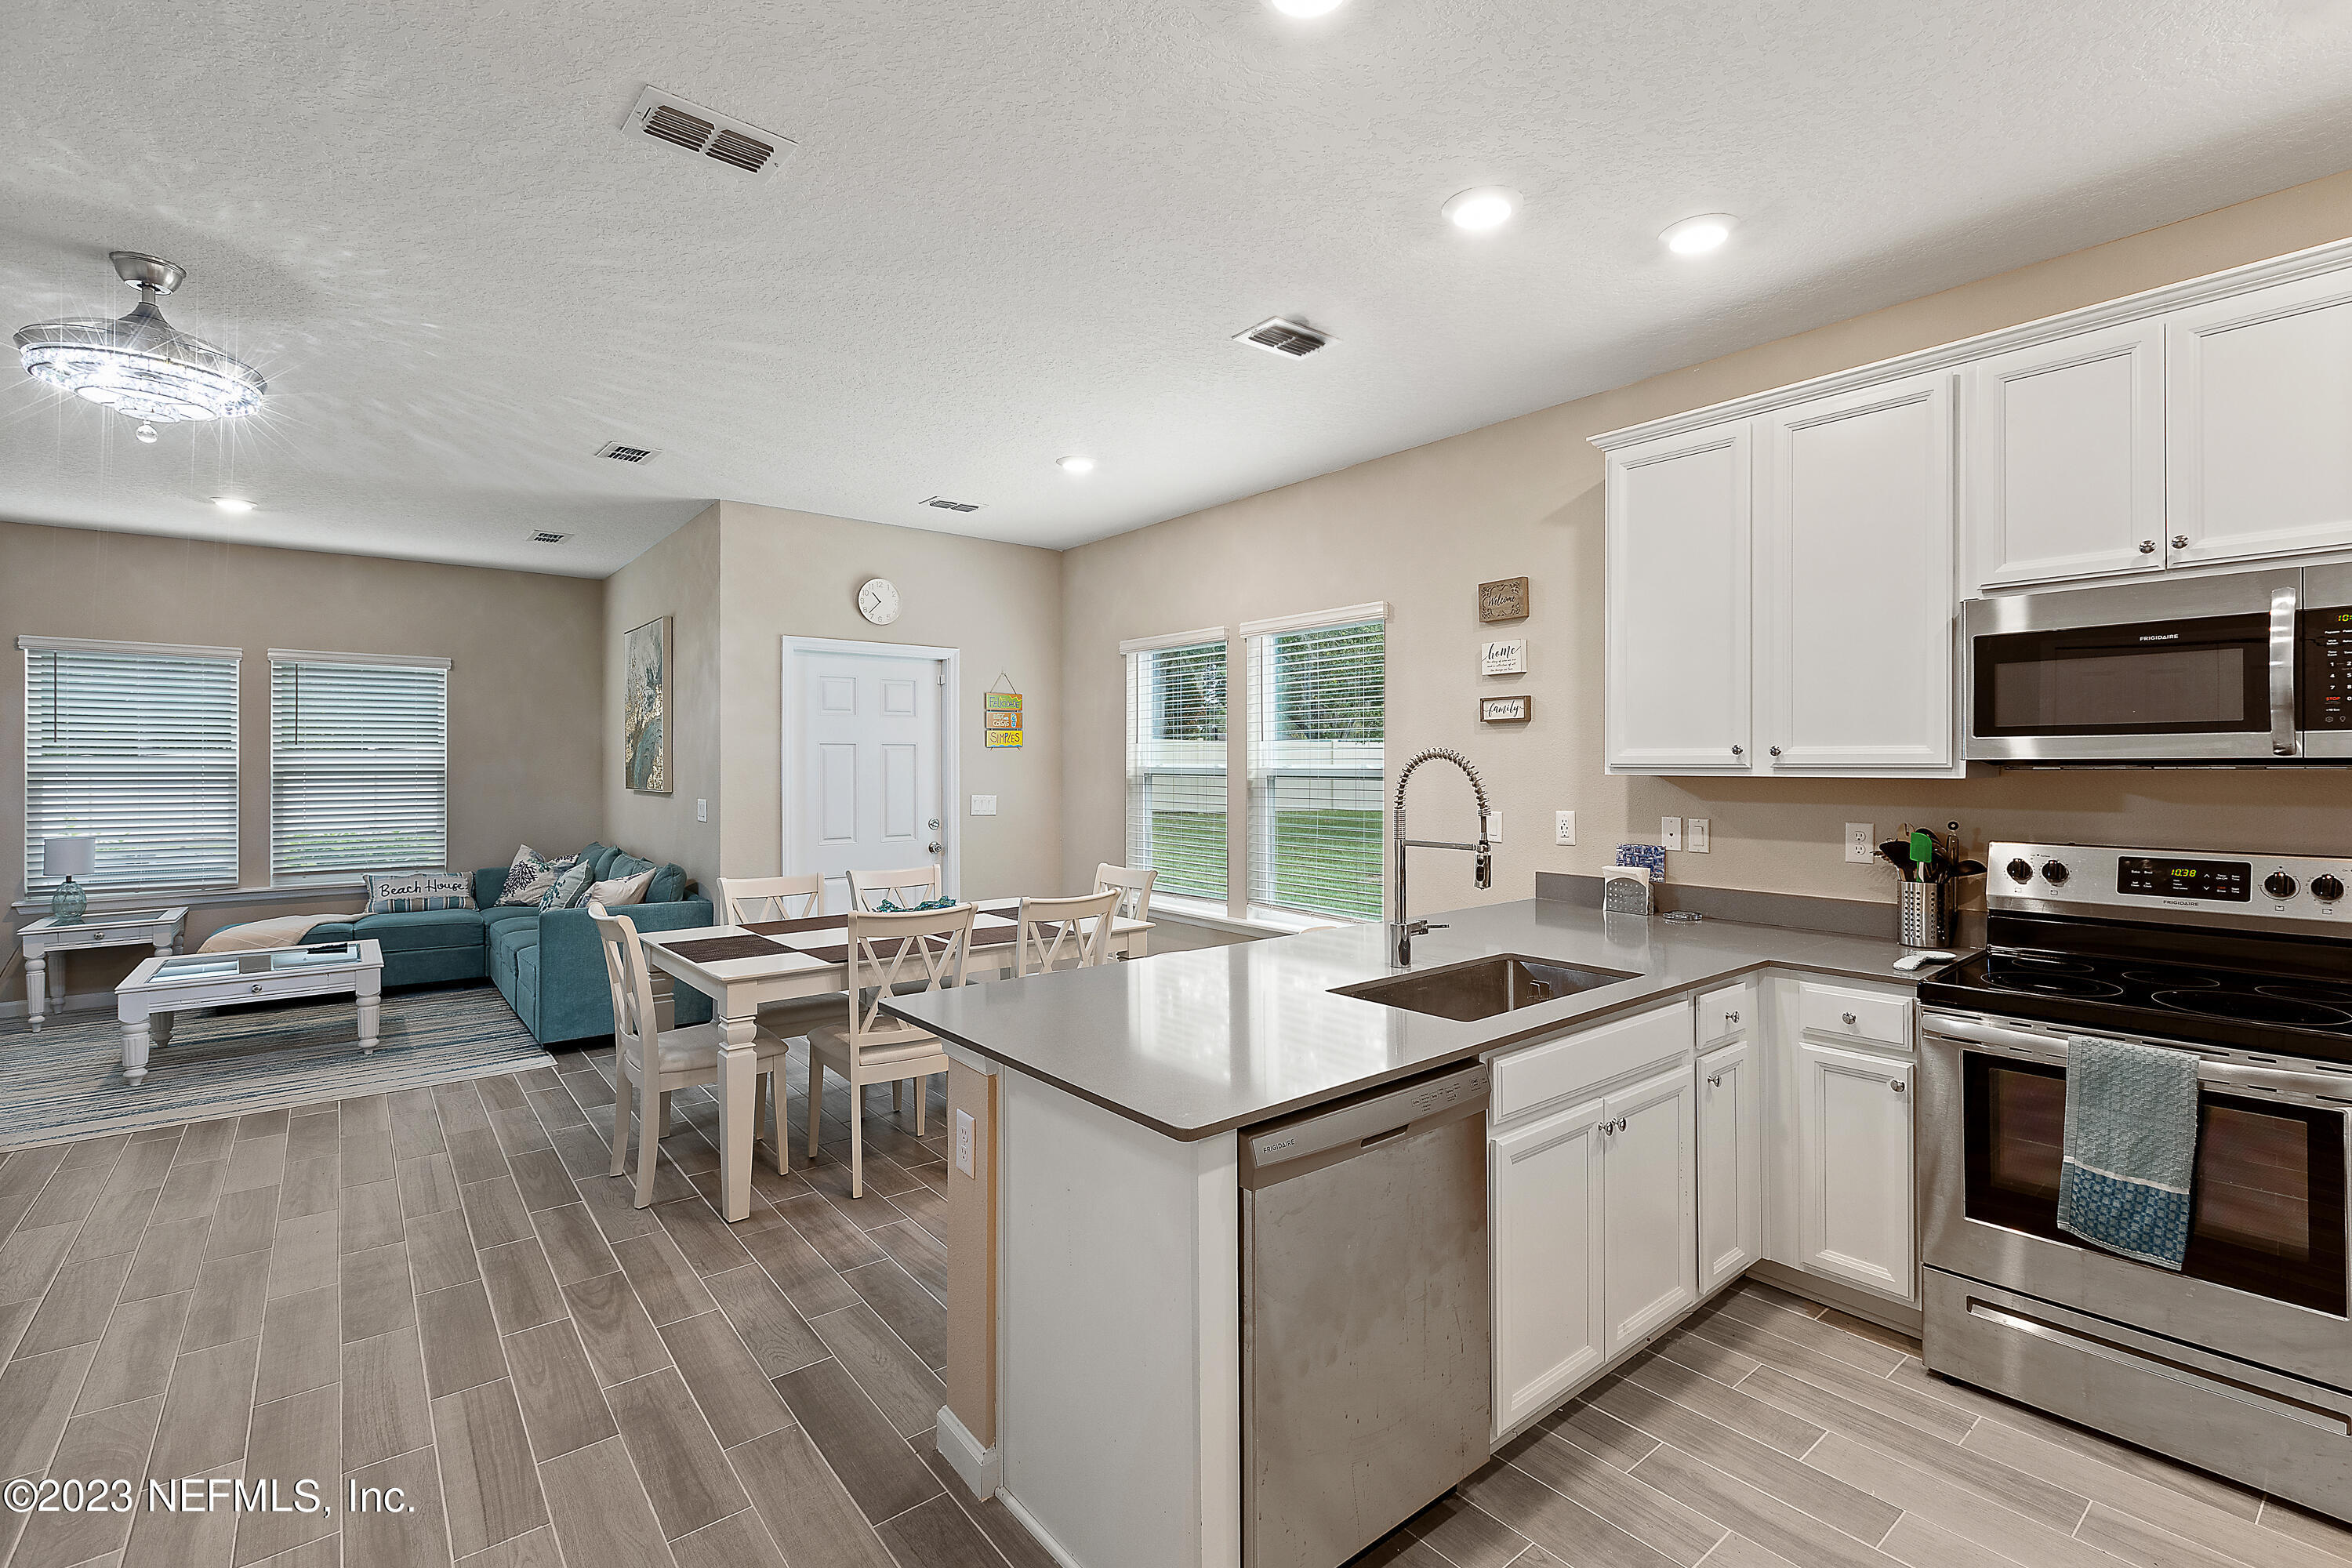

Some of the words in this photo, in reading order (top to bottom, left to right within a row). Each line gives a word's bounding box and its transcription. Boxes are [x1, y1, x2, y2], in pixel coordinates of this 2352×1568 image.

[1488, 593, 1515, 606] Welcome
[1486, 643, 1519, 659] home
[1486, 700, 1521, 717] family
[989, 731, 1020, 744] SIMPLES
[2171, 869, 2197, 877] 10:38
[379, 881, 422, 897] Beach
[425, 879, 465, 892] House
[1263, 1138, 1295, 1154] FRIGIDAIRE
